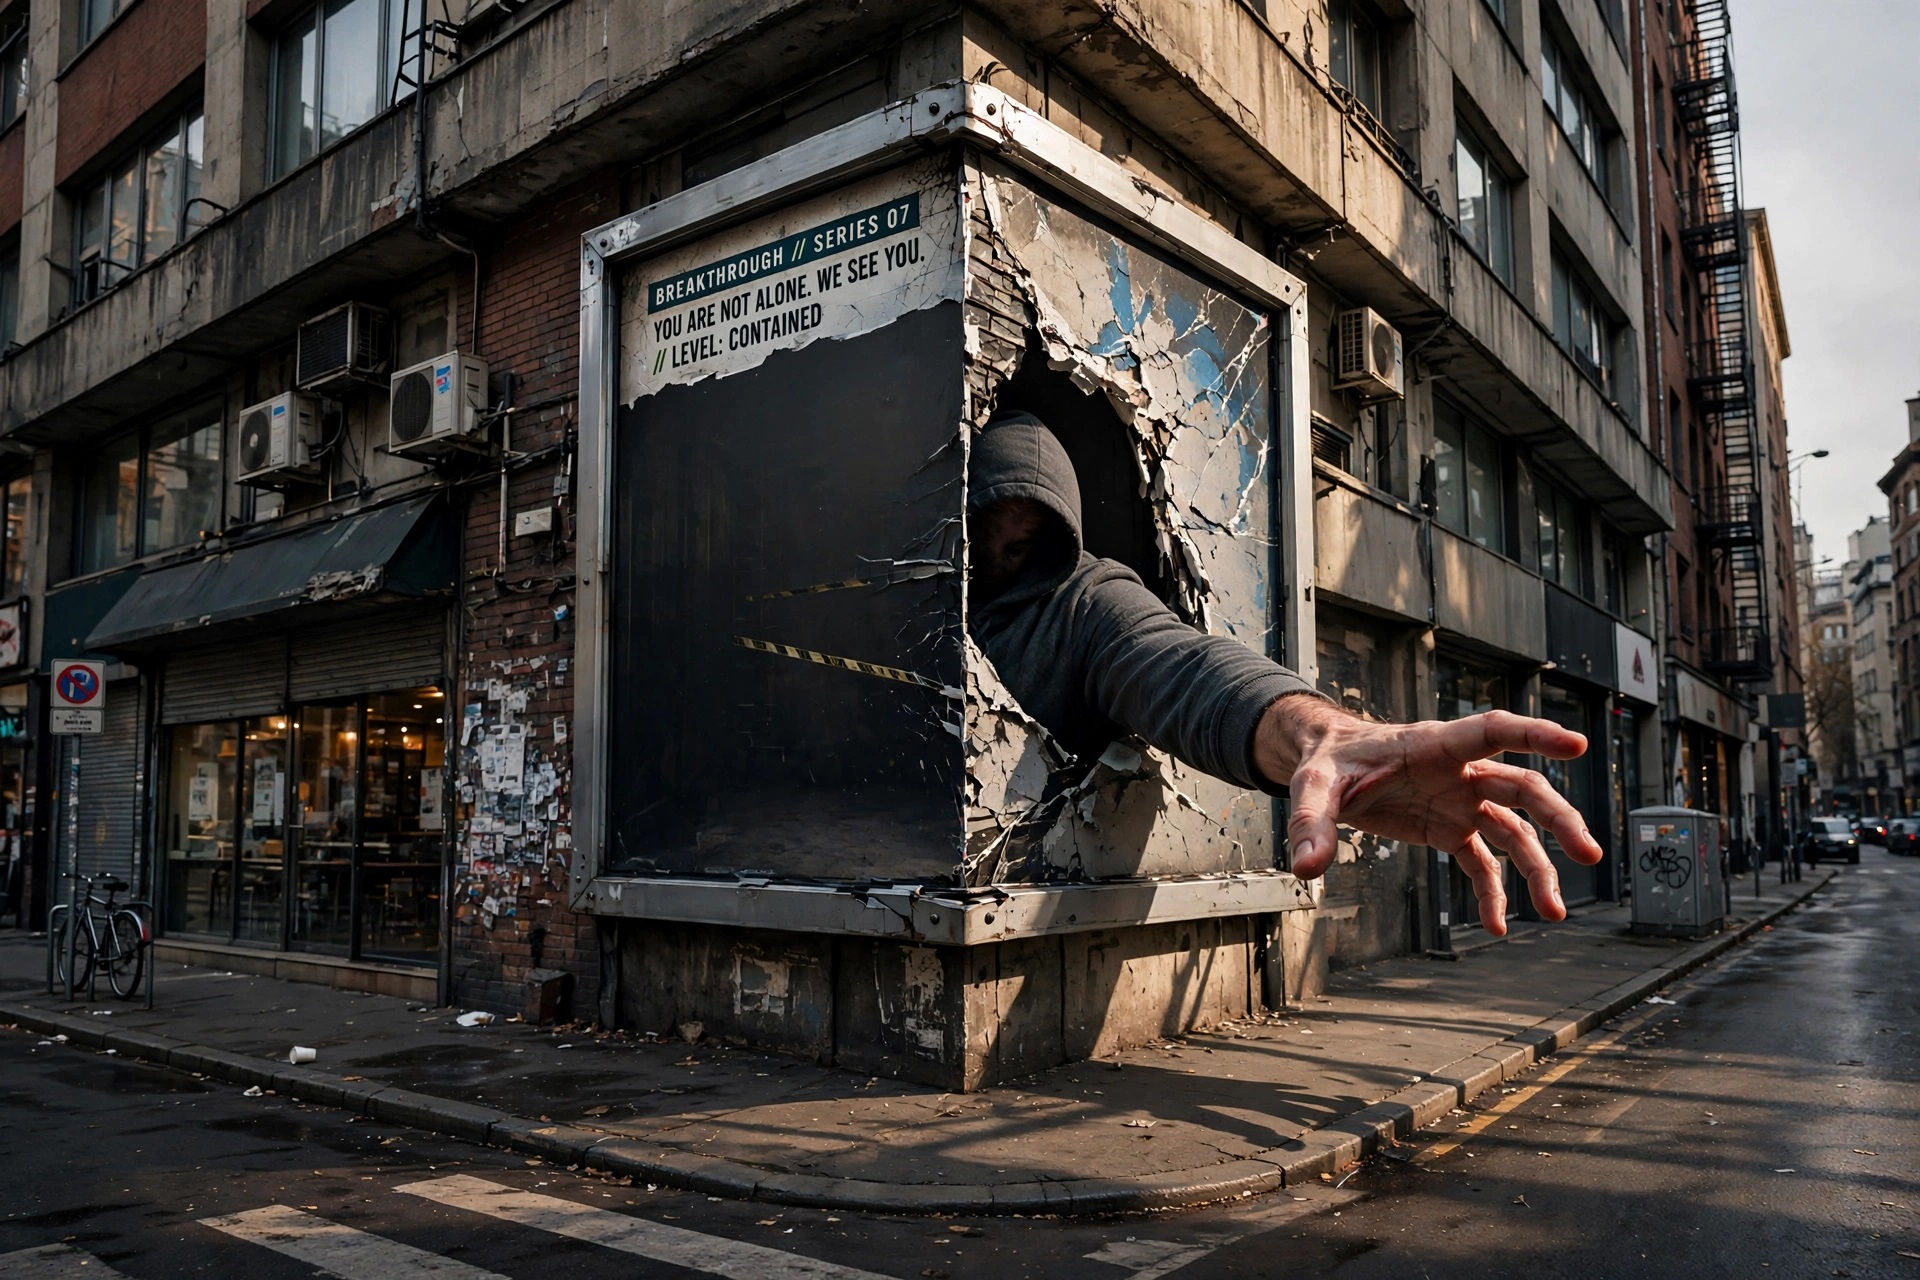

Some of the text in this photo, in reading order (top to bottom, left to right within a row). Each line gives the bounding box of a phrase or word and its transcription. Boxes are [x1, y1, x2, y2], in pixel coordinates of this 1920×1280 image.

[654, 237, 925, 343] YOU ARE NOT ALONE. WE SEE YOU.
[656, 246, 783, 306] BREAKTHROUGH
[813, 214, 878, 253] SERIES
[887, 203, 910, 229] 07
[672, 334, 723, 369] LEVEL:
[729, 302, 822, 351] CONTAINED
